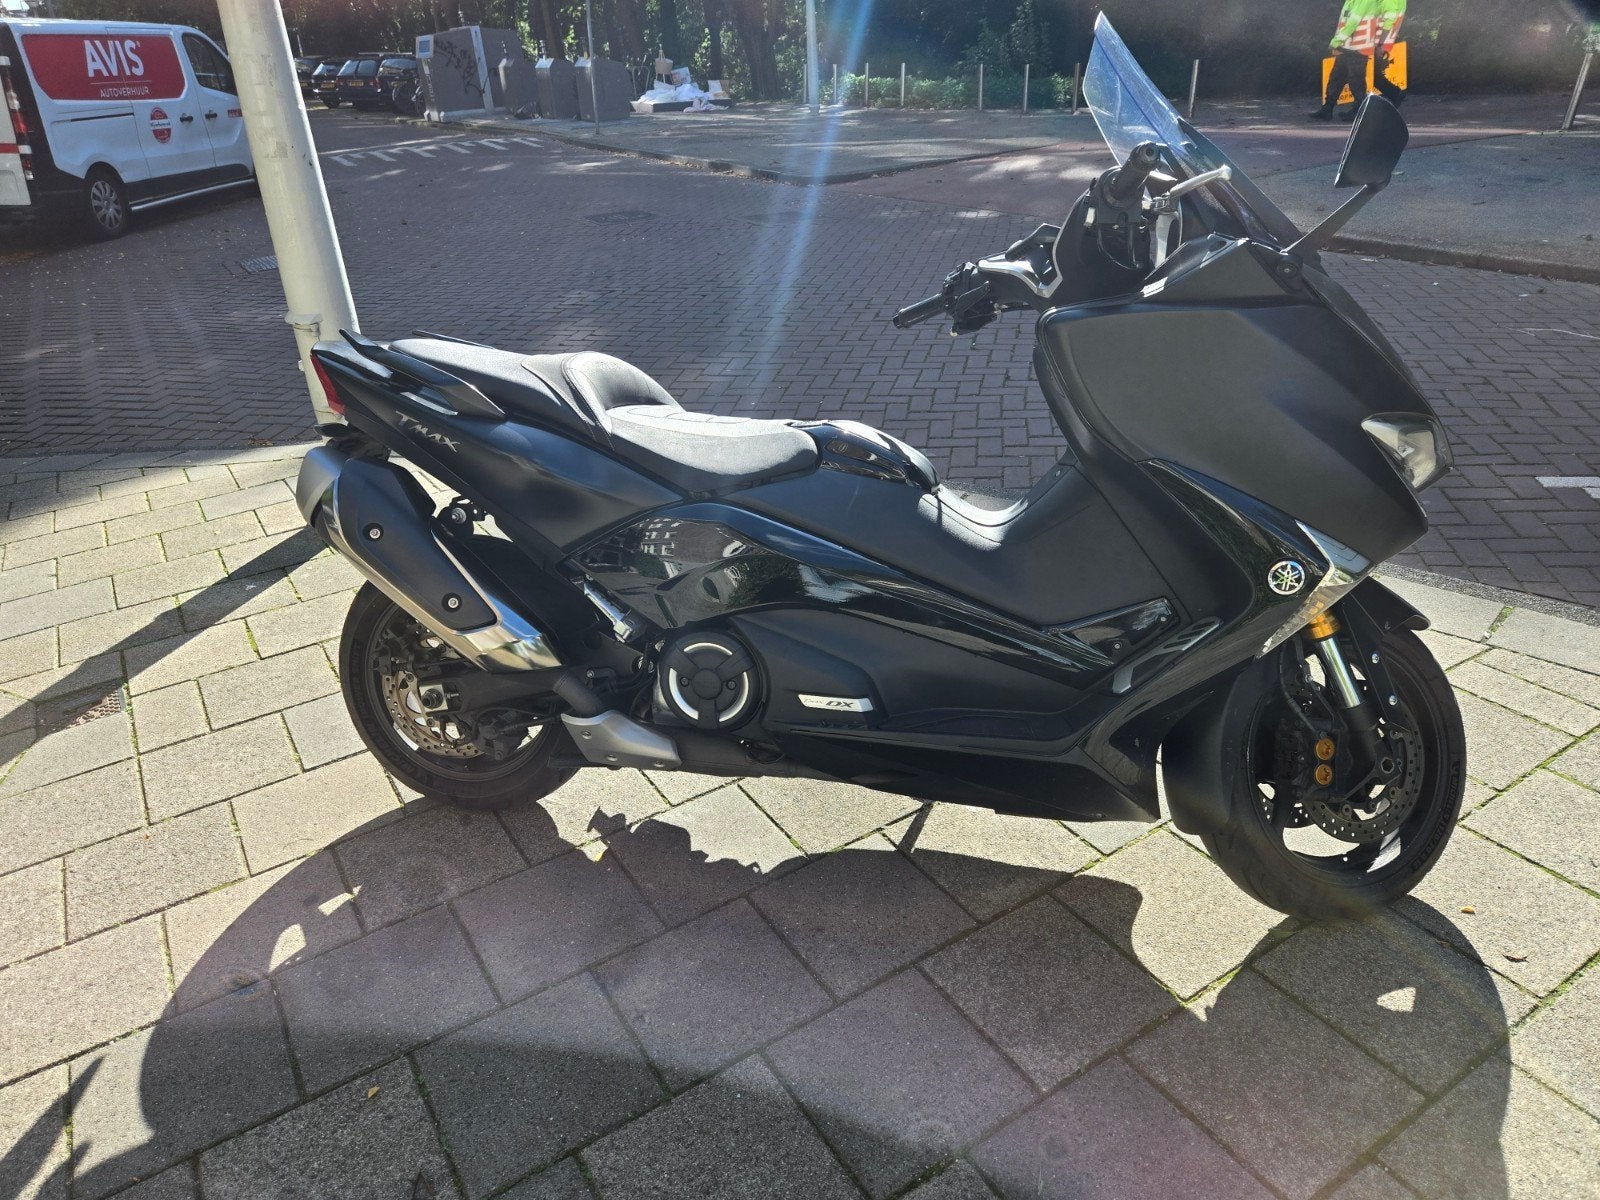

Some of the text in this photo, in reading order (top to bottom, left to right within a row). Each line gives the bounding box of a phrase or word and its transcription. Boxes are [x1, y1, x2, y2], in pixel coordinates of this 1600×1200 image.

[83, 39, 145, 77] AVIS
[100, 86, 150, 98] AUTOVERHUUR
[825, 700, 854, 708] DX
